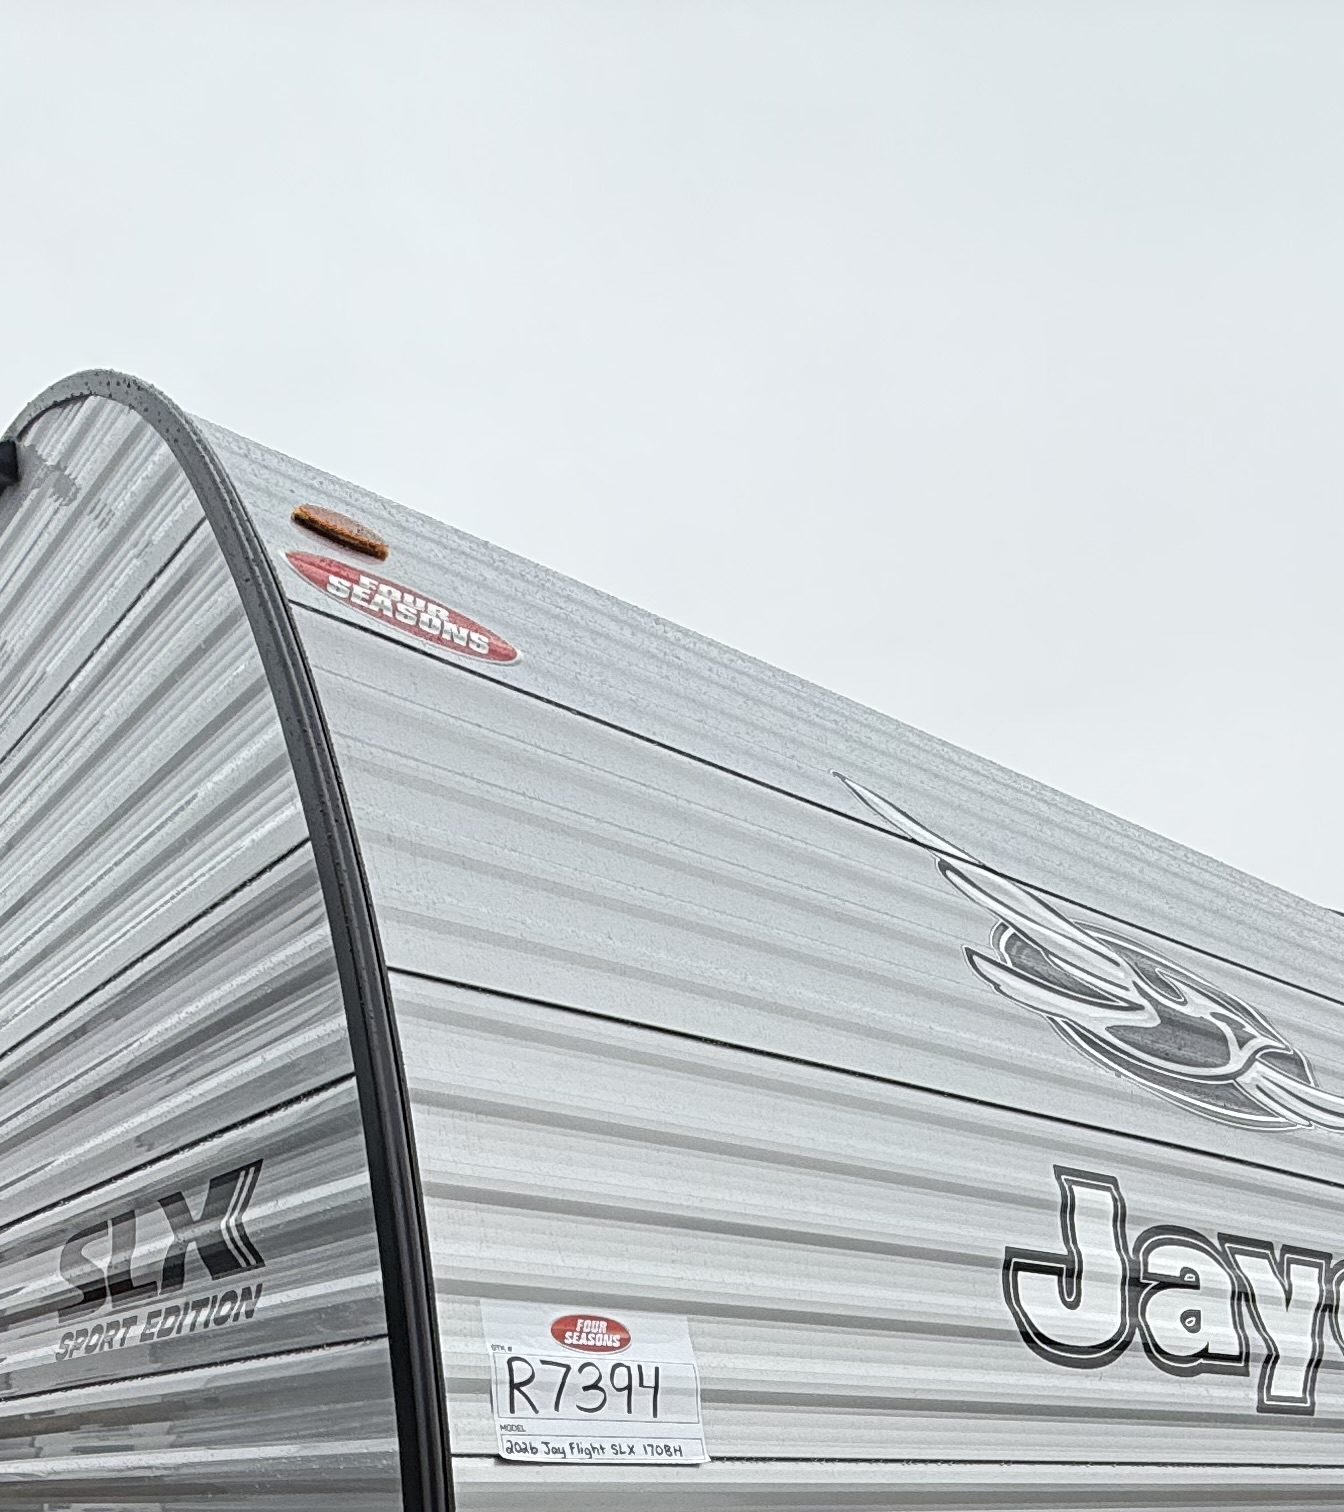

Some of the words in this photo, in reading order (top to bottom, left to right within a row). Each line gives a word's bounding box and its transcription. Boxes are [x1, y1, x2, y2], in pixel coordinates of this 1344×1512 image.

[327, 575, 490, 655] SEASONS
[359, 574, 450, 621] FOUR
[57, 1158, 266, 1324] SLX
[56, 1315, 138, 1361] SPORT
[140, 1283, 263, 1342] EDITION
[564, 1331, 621, 1348] SEASONS
[575, 1318, 608, 1333] FOUR
[507, 1356, 660, 1419] R7394
[499, 1423, 526, 1433] MODEL
[505, 1440, 539, 1455] 2026
[541, 1441, 567, 1459] Jay
[569, 1441, 606, 1459] Flight
[610, 1443, 635, 1456] SLX
[642, 1443, 684, 1458] 170BH
